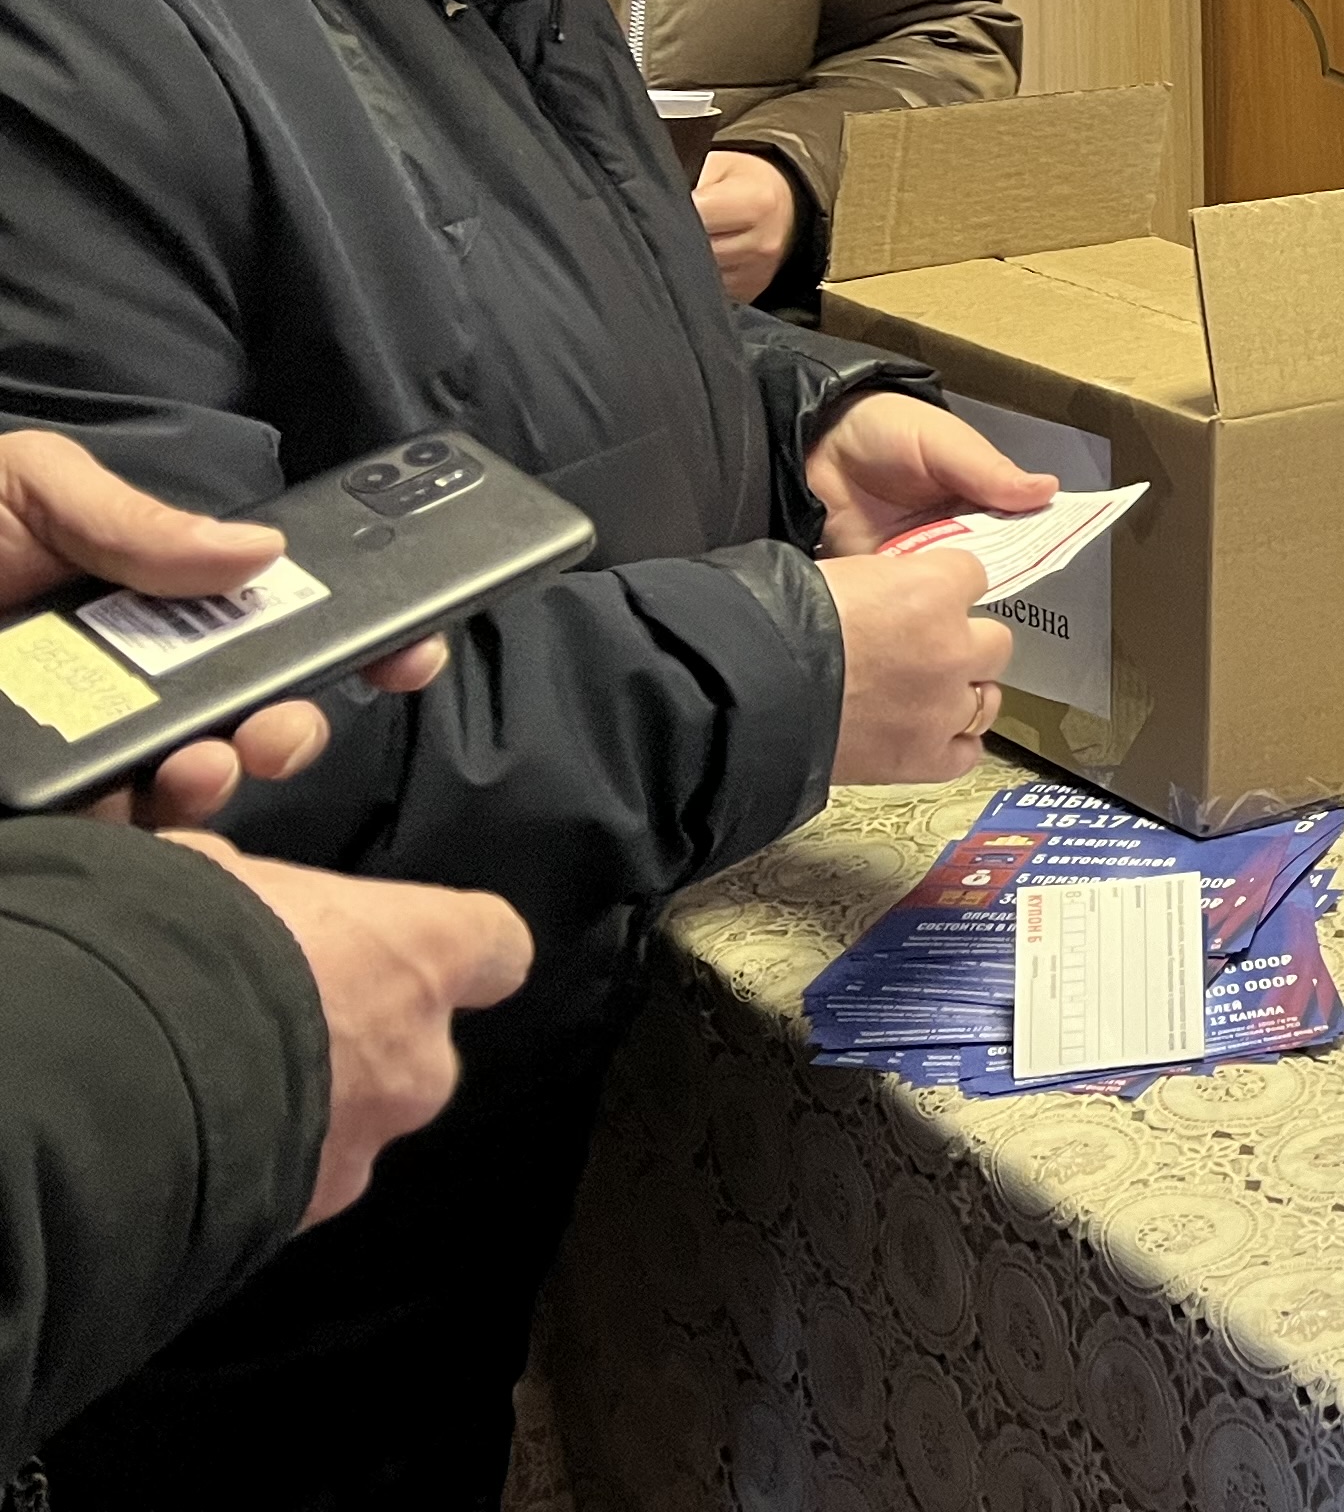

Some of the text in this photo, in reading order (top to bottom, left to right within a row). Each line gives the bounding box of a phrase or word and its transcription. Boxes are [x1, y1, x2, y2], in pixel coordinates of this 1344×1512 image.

[1063, 838, 1141, 849] квартир
[1047, 853, 1176, 867] автомобилей
[1229, 1005, 1284, 1022] КАНАЛА
